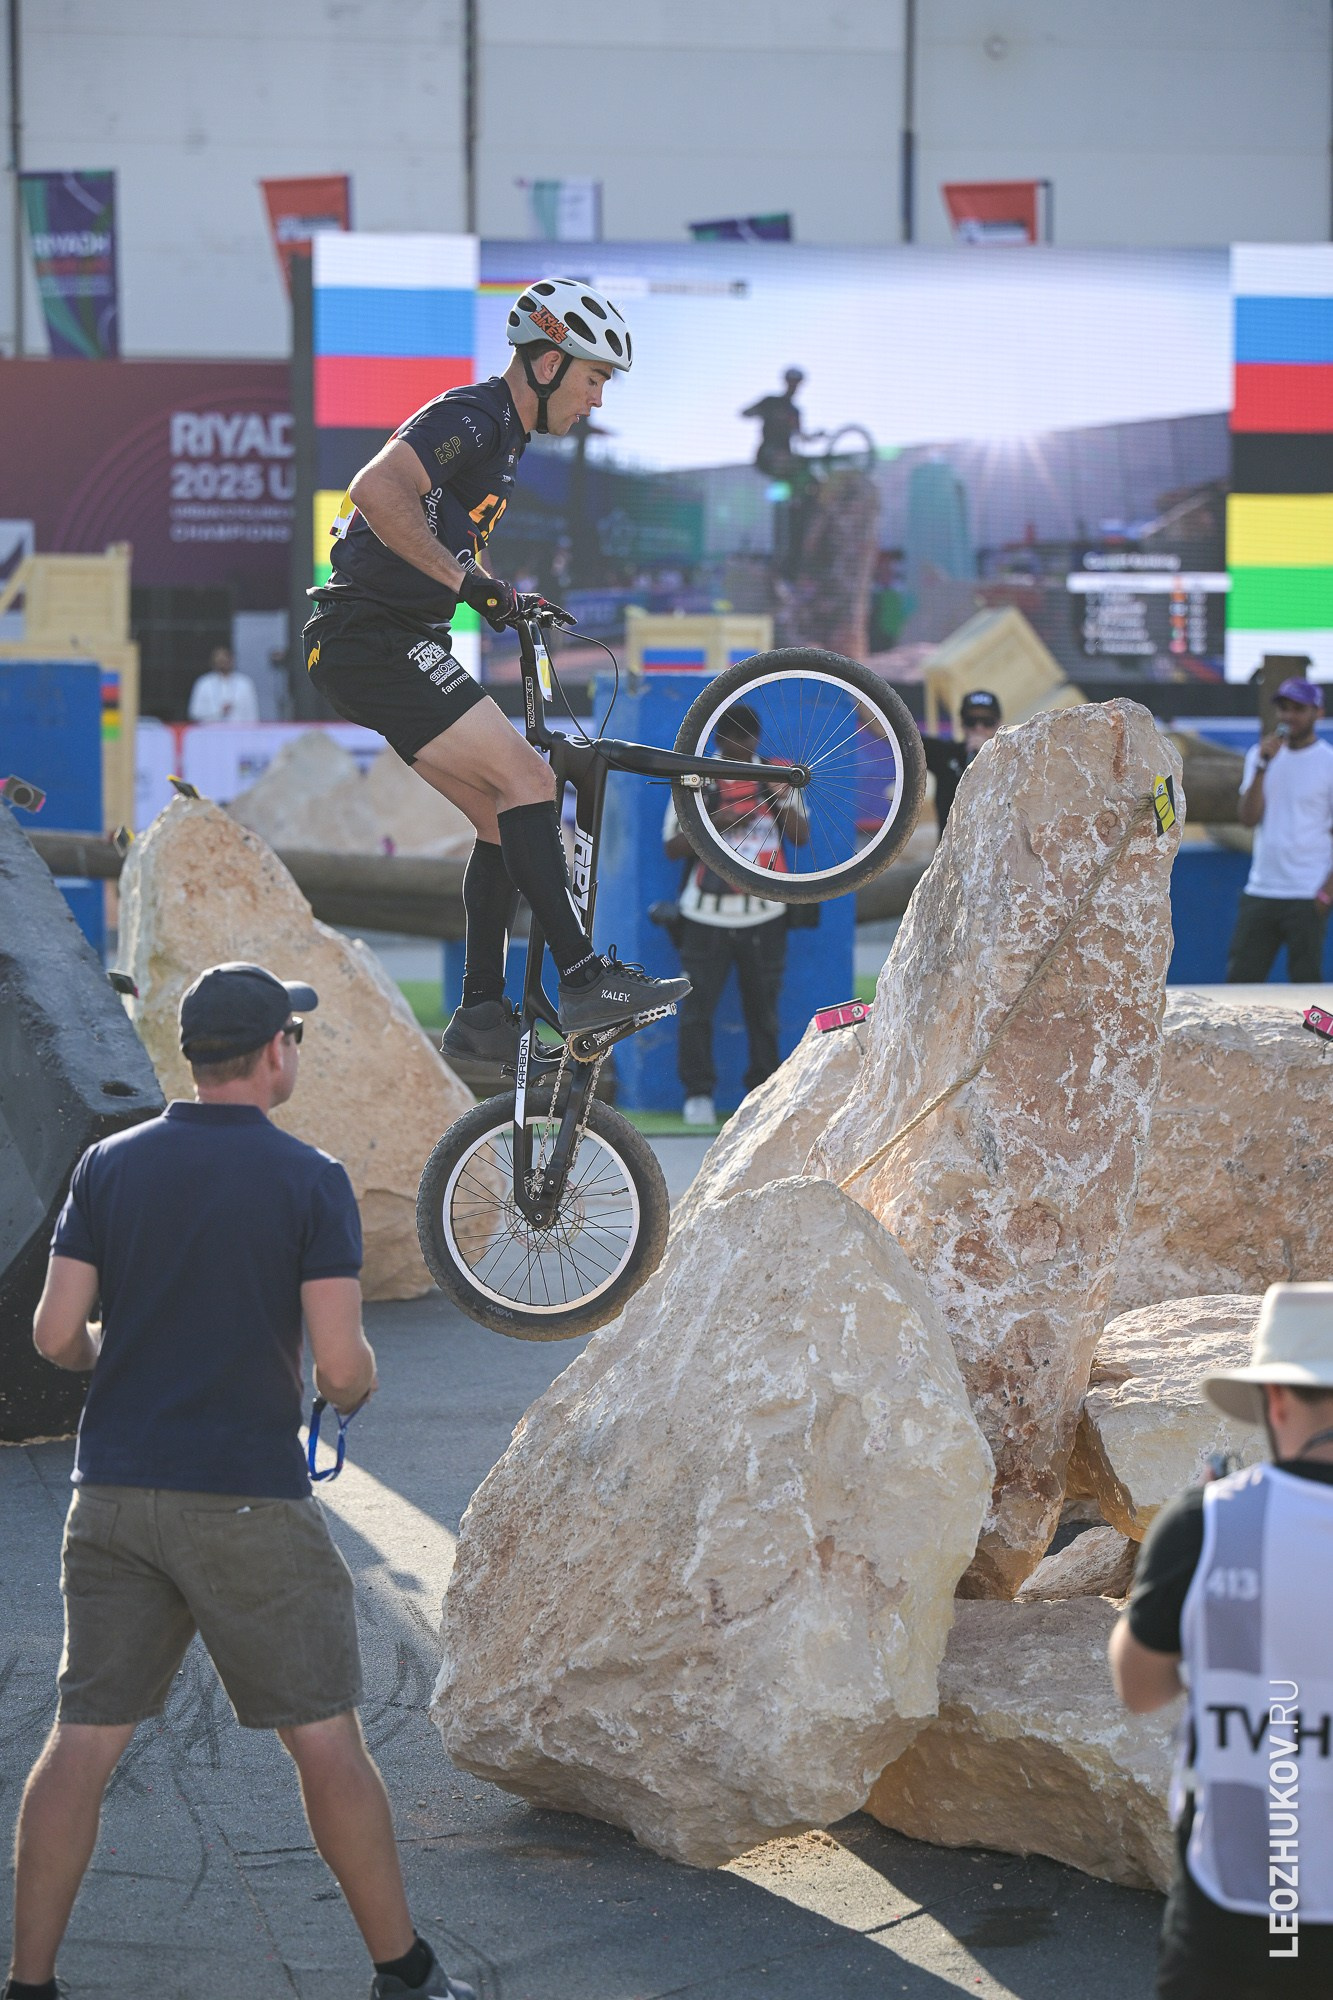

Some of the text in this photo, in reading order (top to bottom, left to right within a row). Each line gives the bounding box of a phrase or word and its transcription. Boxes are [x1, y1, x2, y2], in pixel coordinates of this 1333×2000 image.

[529, 311, 567, 344] BIKES
[540, 305, 569, 334] TRIAL
[434, 435, 461, 465] ESP
[171, 463, 264, 499] 2025
[413, 641, 441, 663] TRIAL
[418, 646, 446, 671] BIKES
[517, 1039, 529, 1090] KARBON
[1206, 1567, 1260, 1600] 413
[1206, 1706, 1272, 1753] TV
